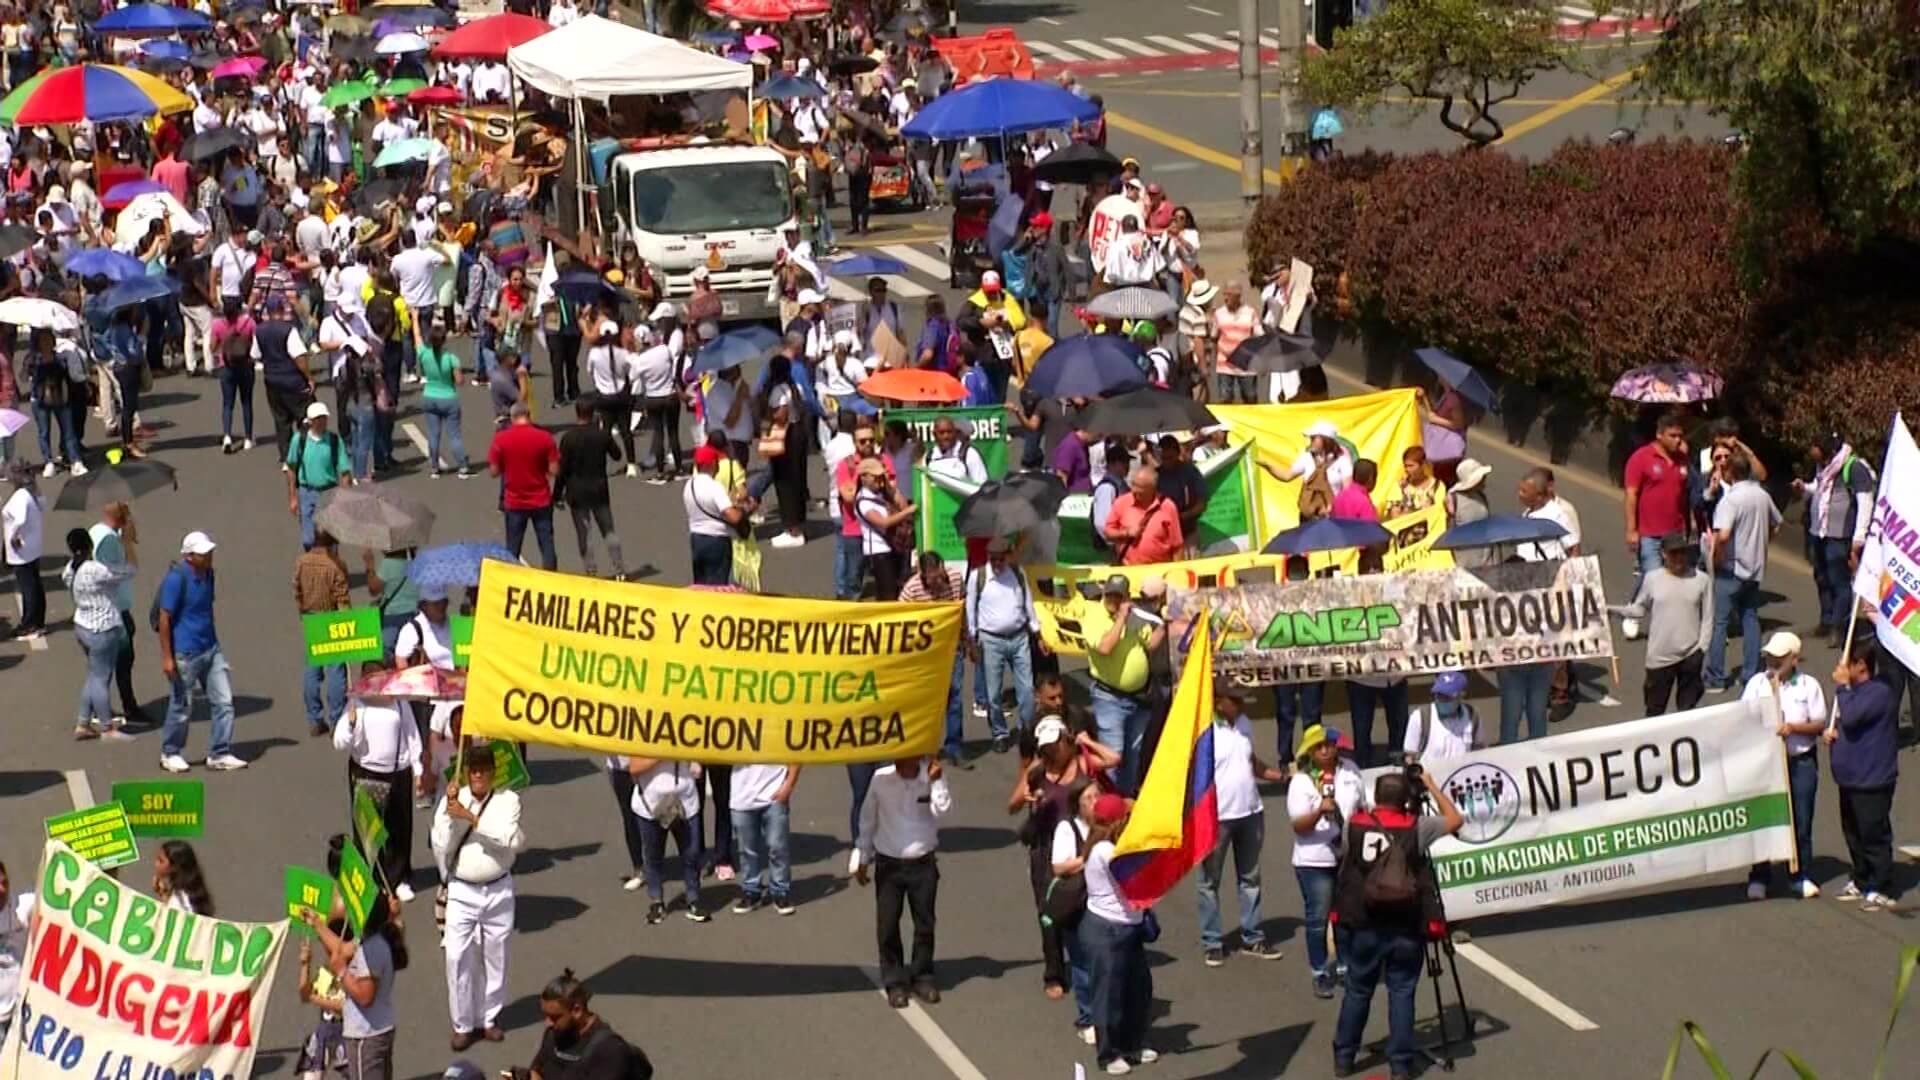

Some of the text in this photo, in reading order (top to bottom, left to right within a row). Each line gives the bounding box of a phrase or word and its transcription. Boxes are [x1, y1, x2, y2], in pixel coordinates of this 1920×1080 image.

[328, 620, 357, 639] SOY
[503, 586, 935, 656] FAMILIARES Y SOBREVIVIENTES
[1415, 587, 1605, 645] ANTIOQUIA
[539, 645, 881, 705] UNION PATRIOTICA
[1331, 658, 1363, 675] EN
[1372, 656, 1400, 673] LA
[1410, 650, 1494, 670] LUCHA
[1502, 638, 1601, 662] SOCIAL!
[502, 687, 906, 752] COORDINACION URABA
[142, 793, 174, 810] SOY
[1526, 735, 1702, 817] NPECO
[1482, 843, 1580, 876] NACIONAL
[1584, 834, 1609, 857] DE
[1613, 806, 1748, 851] PENSIONADOS
[42, 850, 274, 977] CABILDO
[1475, 879, 1549, 904] SECCIONAL
[1563, 863, 1636, 889] ANTIOQUIA
